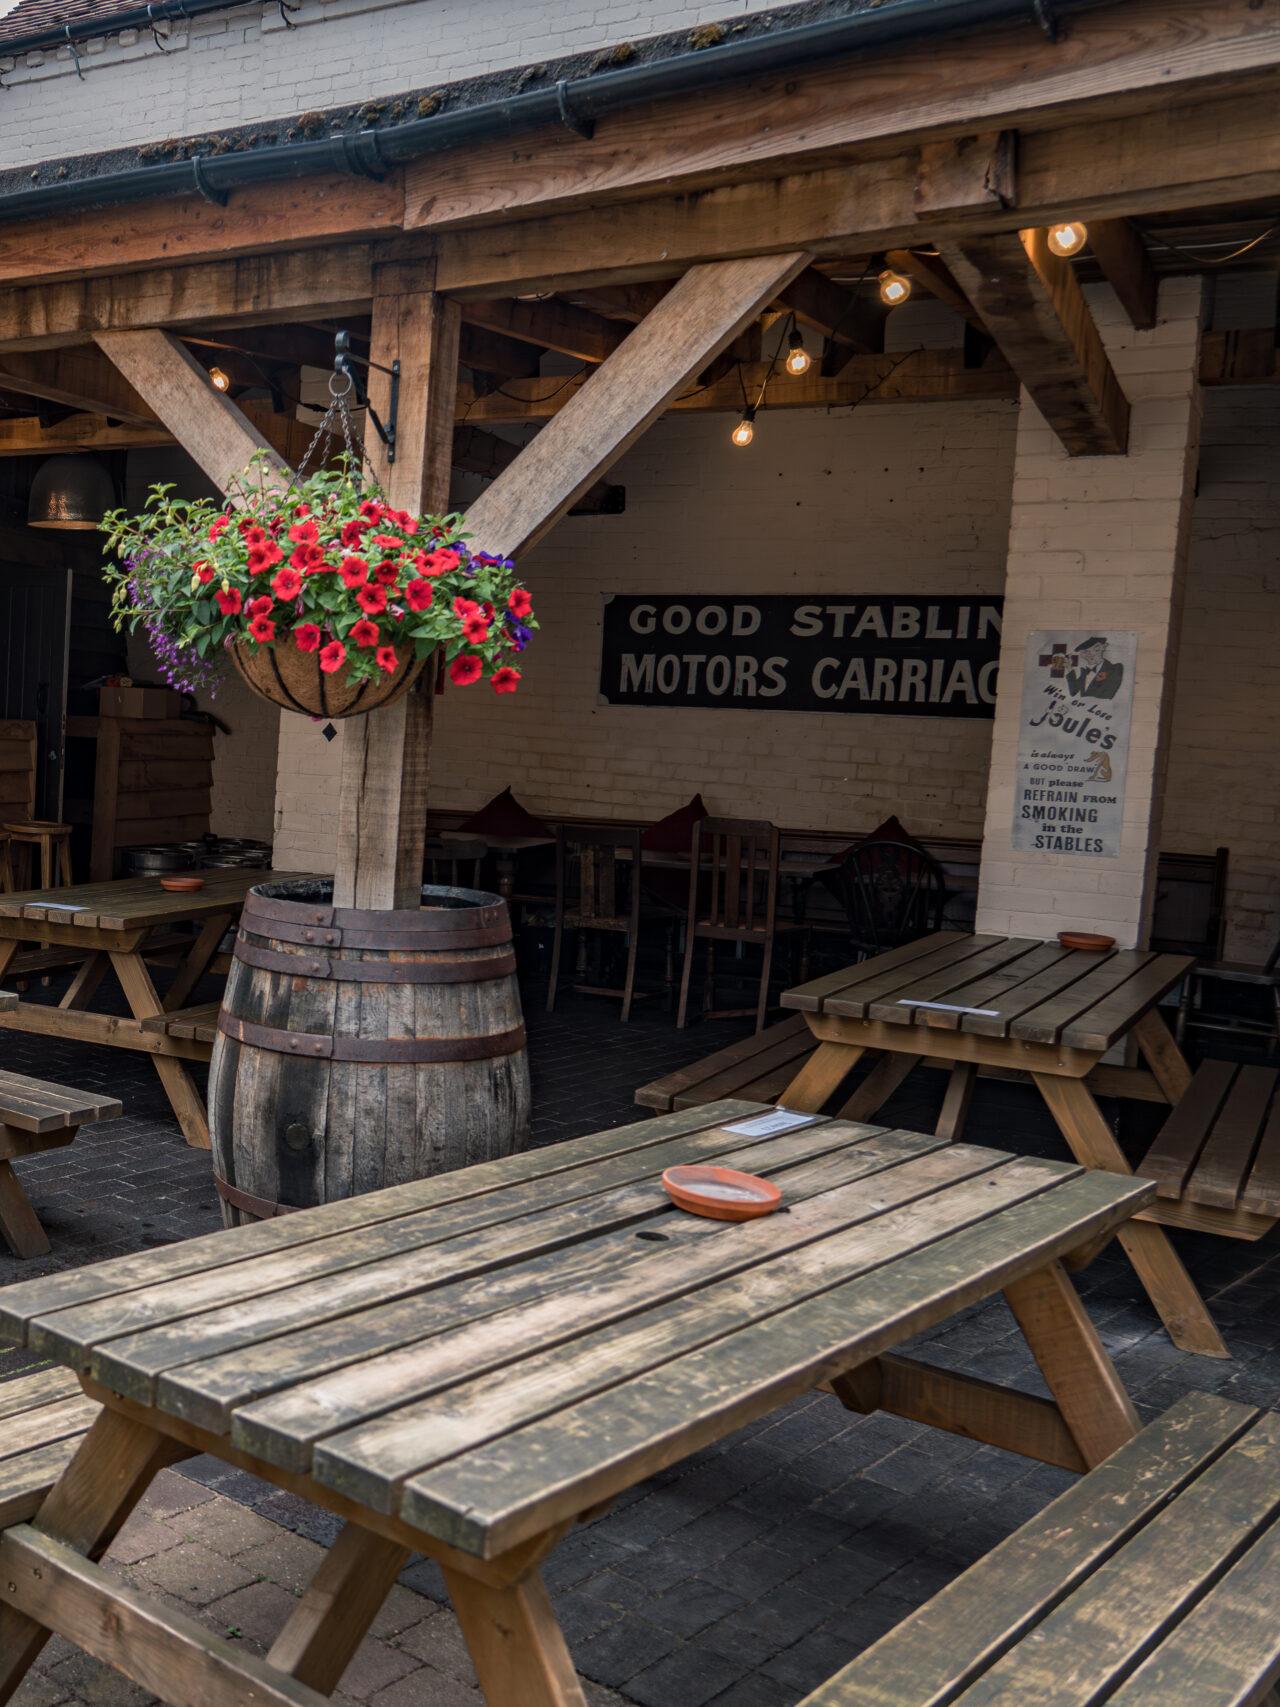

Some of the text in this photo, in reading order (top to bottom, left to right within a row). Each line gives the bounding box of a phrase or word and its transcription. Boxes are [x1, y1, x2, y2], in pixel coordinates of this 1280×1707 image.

[629, 604, 1001, 640] GOOD STABLIN
[619, 653, 790, 698] MOTORS
[1043, 685, 1066, 701] Win
[1087, 704, 1112, 721] Lose
[1030, 749, 1075, 761] is always
[1033, 763, 1063, 771] GOOD
[1029, 777, 1084, 787] BUT please
[1023, 789, 1117, 804] REFRAIN FROM
[1021, 804, 1098, 823] SMOKING
[1042, 823, 1083, 834] in the
[1035, 835, 1103, 853] STABLES
